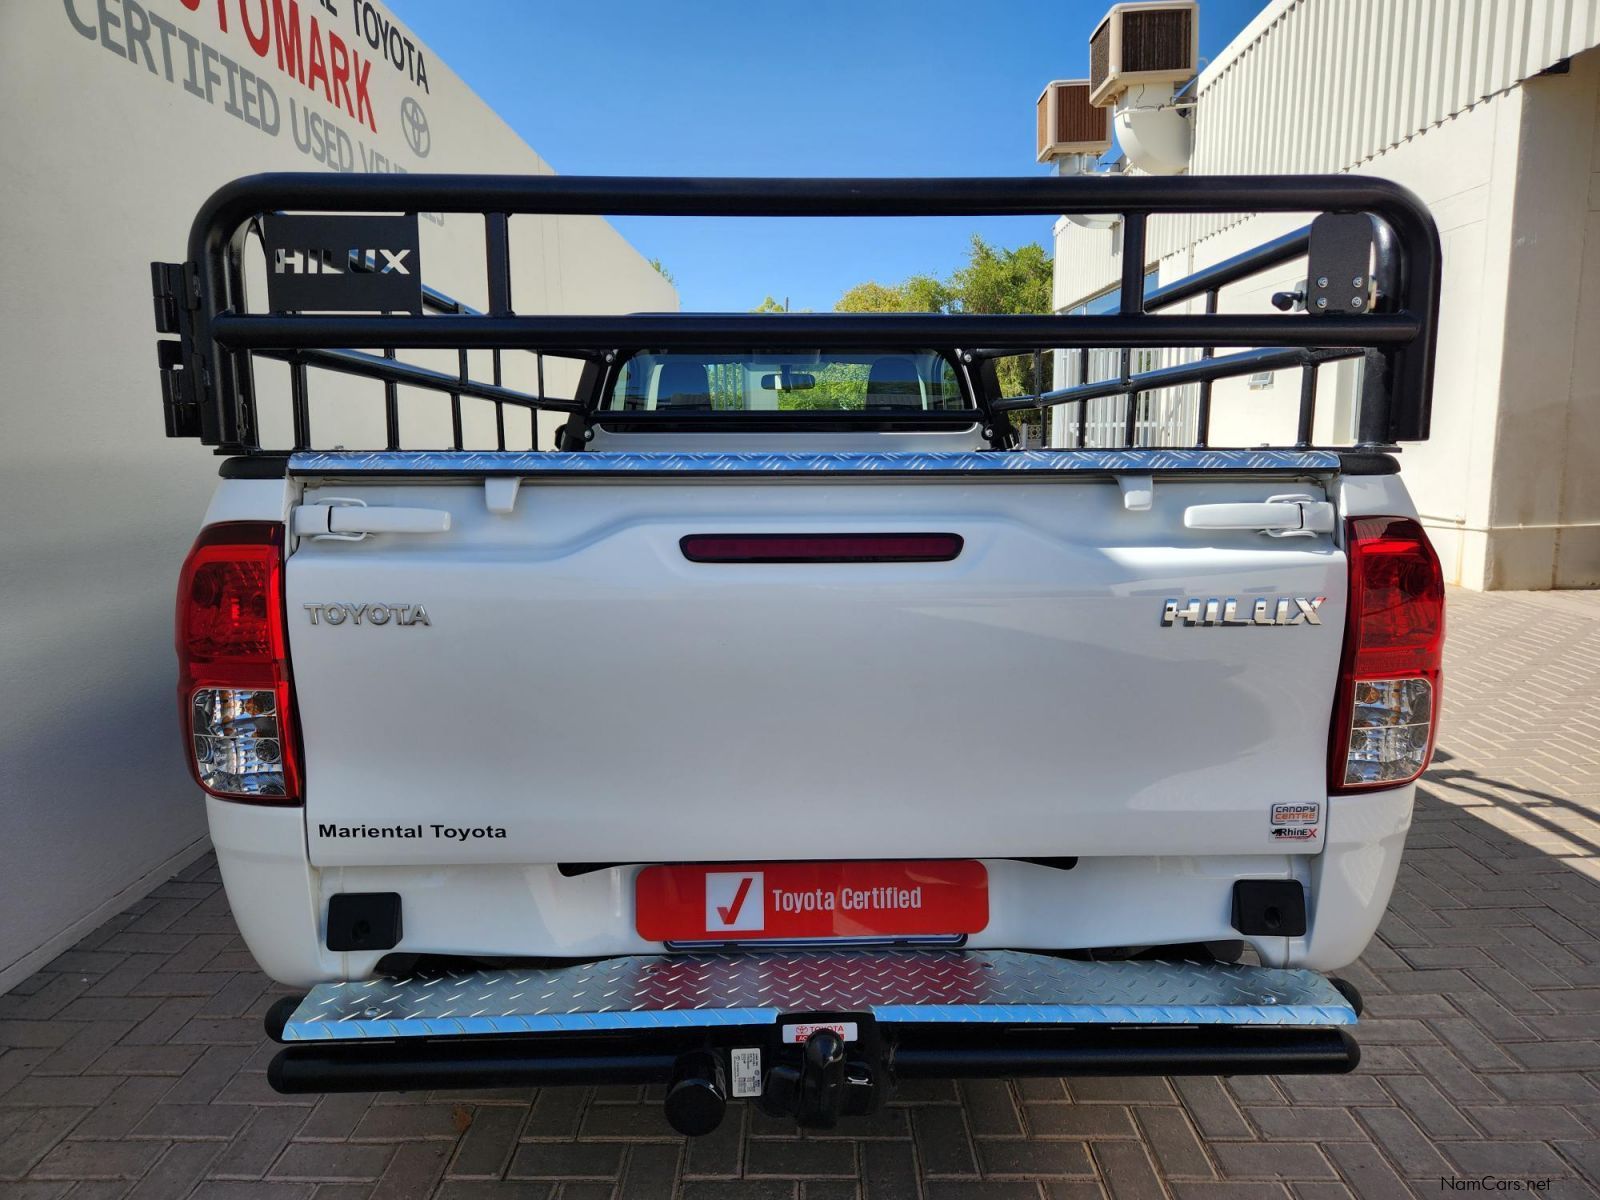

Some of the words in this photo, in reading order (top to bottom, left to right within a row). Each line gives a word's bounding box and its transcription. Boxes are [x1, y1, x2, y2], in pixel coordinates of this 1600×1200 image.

[352, 0, 430, 95] TOYOTA
[178, 0, 377, 134] OMARK
[64, 0, 280, 137] CERTIFIED
[289, 97, 354, 173] USED
[275, 249, 411, 274] HILUX
[304, 603, 432, 626] TOYOTA
[1160, 597, 1327, 627] HILUX
[319, 824, 422, 838] Mariental
[430, 825, 507, 842] Toyota
[772, 888, 835, 914] Toyota
[841, 887, 922, 911] Certified
